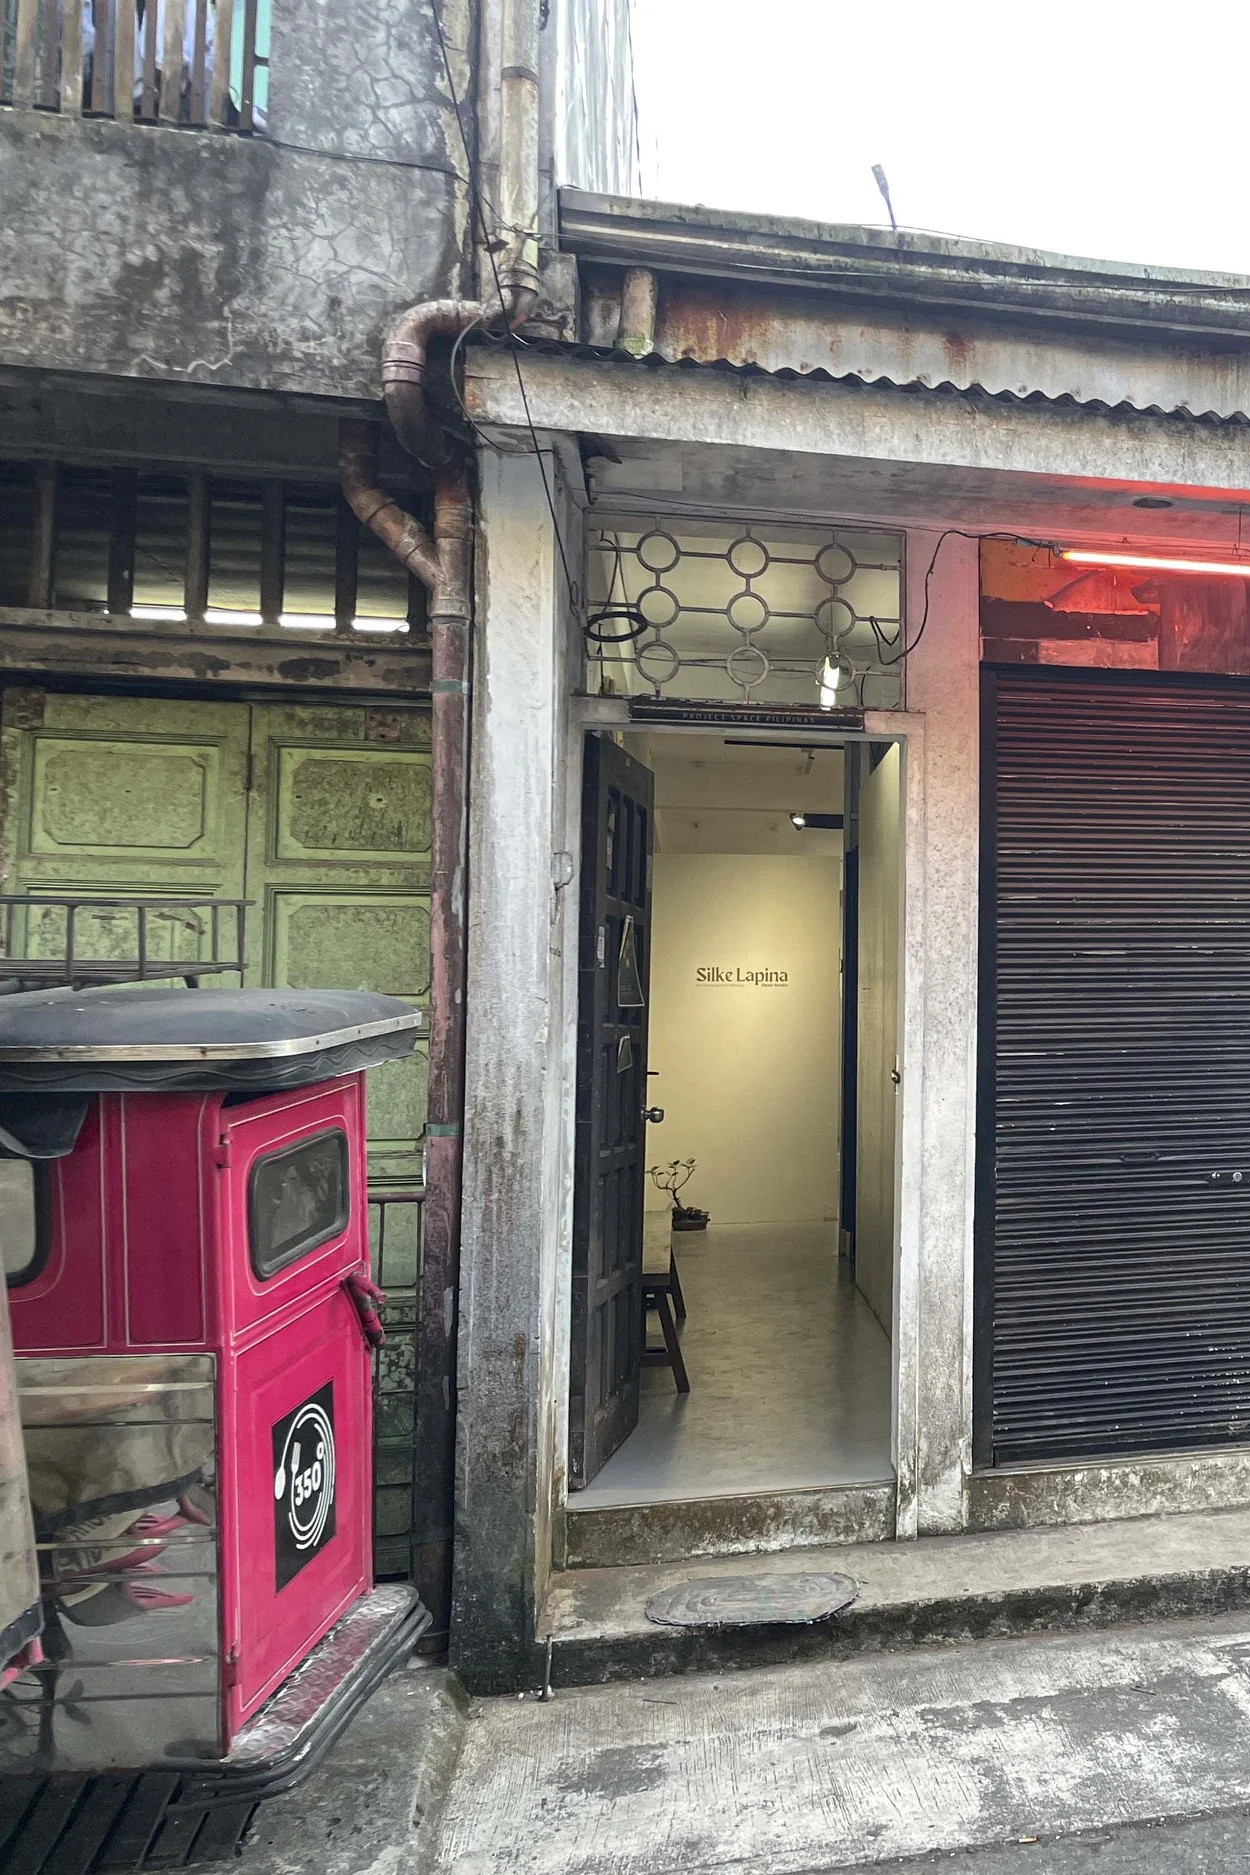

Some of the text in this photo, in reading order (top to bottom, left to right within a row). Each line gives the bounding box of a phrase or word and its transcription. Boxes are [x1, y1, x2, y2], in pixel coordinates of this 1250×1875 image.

[682, 712, 816, 724] PROJECT SPACE PILIPINAS
[696, 966, 788, 986] Silke Lapina
